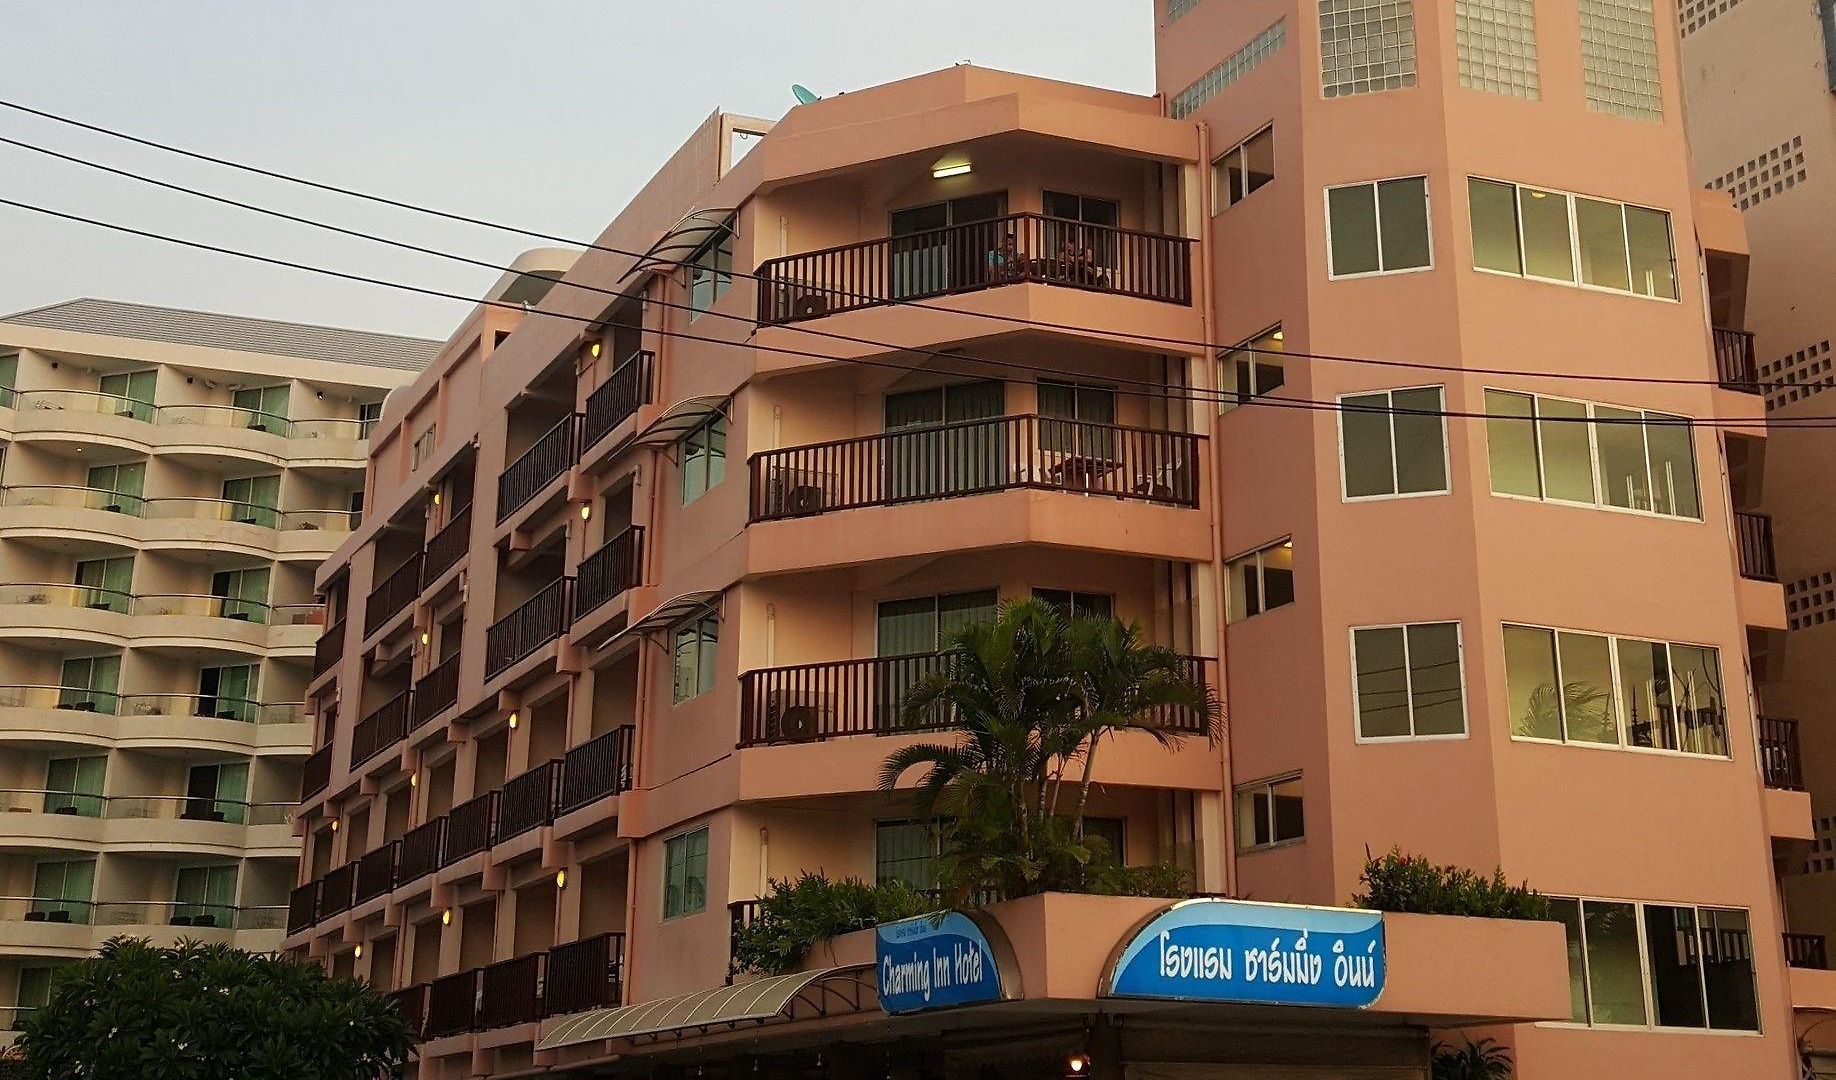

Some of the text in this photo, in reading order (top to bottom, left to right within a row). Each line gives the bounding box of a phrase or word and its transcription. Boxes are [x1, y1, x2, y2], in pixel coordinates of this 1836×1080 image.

[882, 939, 983, 1002] Charming Inn Hotel
[1160, 930, 1232, 980] โรงแรม
[1332, 939, 1376, 988] อินน์
